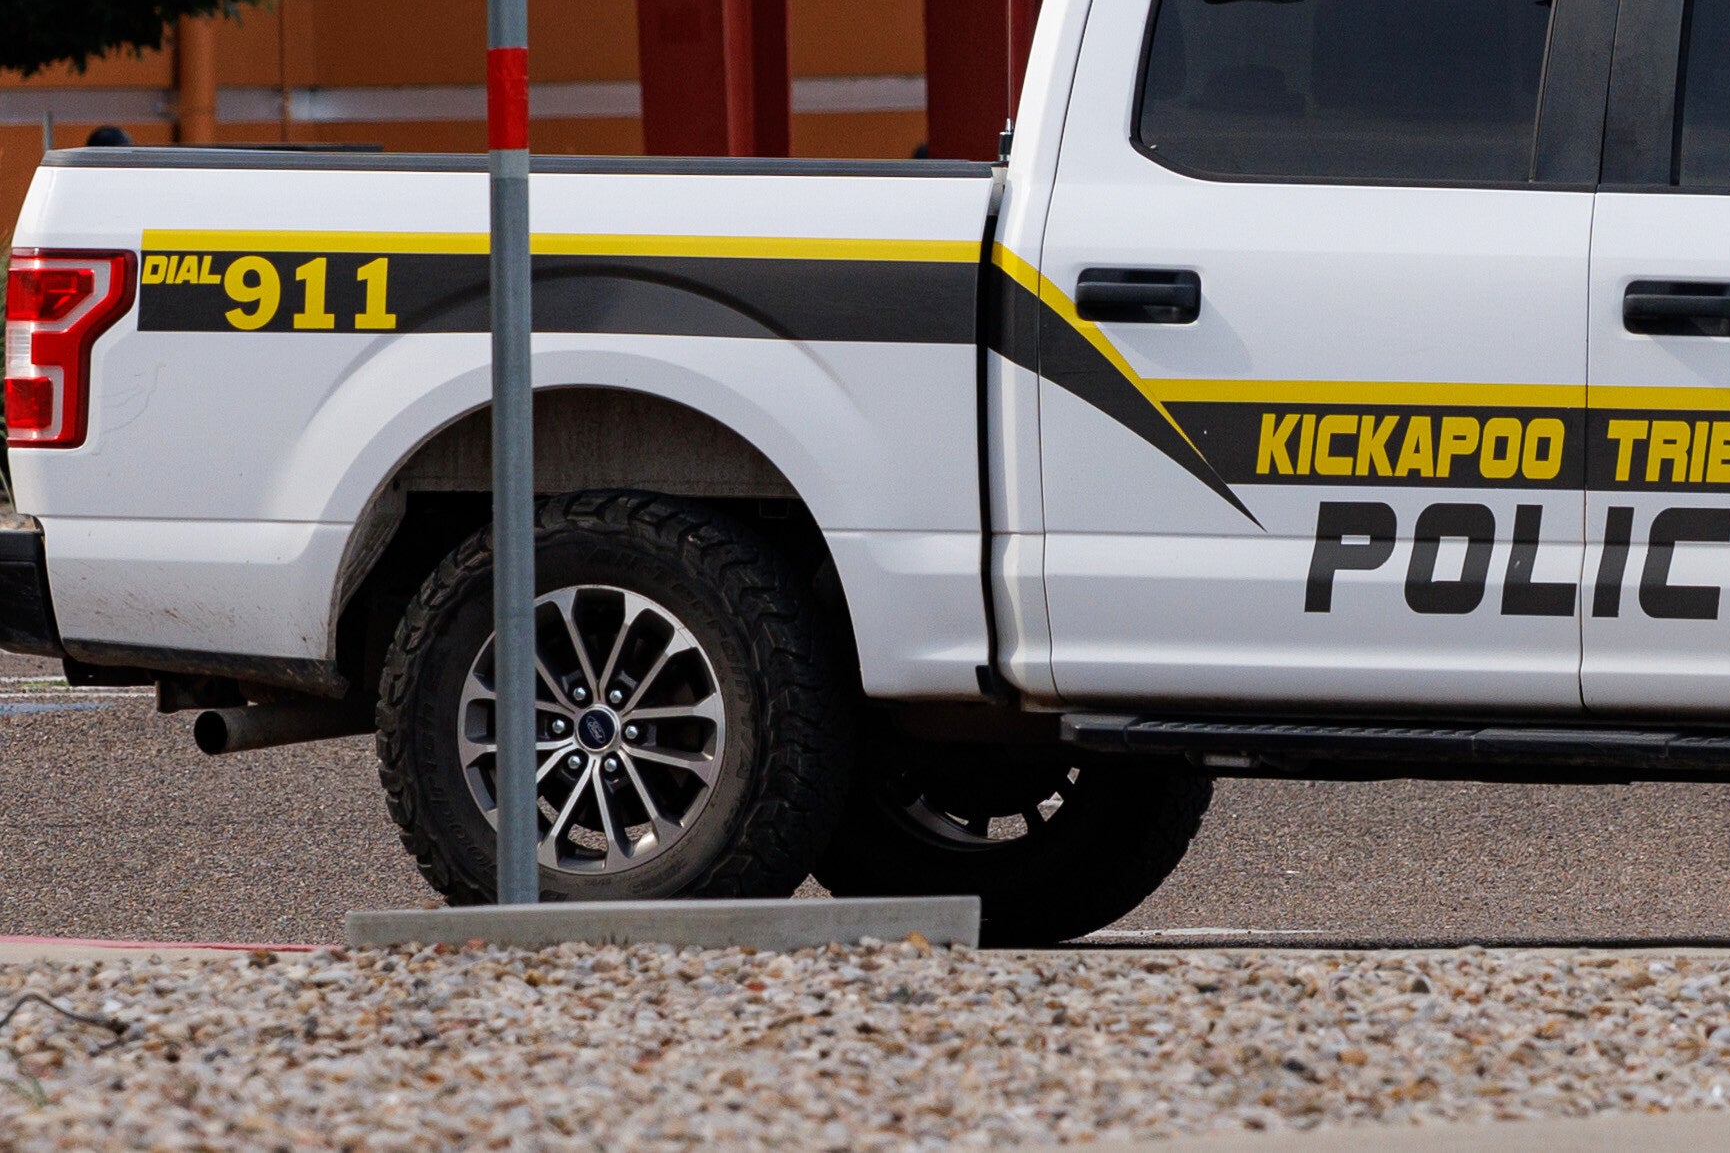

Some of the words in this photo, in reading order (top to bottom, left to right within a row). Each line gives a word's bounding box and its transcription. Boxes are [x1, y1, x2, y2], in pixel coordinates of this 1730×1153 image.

[141, 255, 223, 285] DIAL
[223, 255, 397, 330] 911
[1256, 413, 1565, 480] KICKAPOO
